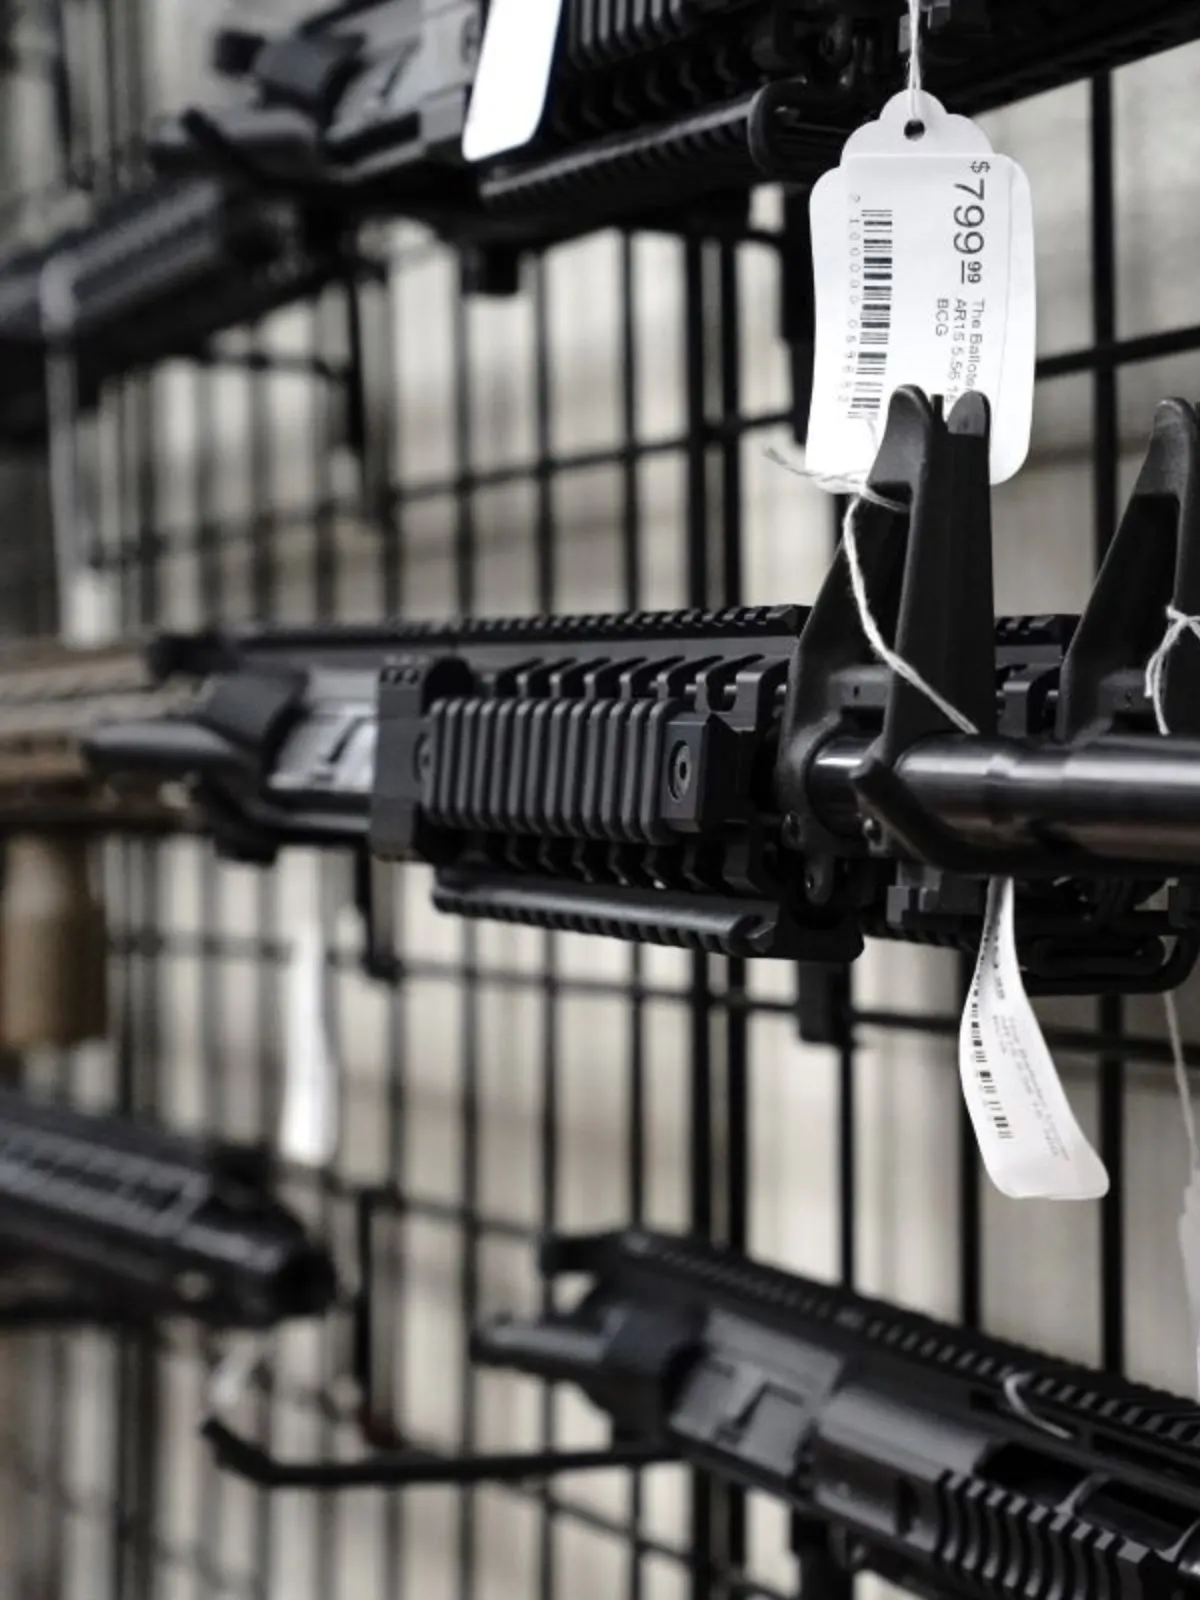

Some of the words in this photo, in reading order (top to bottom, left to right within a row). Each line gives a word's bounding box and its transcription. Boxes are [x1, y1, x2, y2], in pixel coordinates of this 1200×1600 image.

[935, 297, 950, 337] BCG
[953, 298, 968, 342] AR15
[971, 298, 986, 329] The
[966, 333, 983, 393] Ballote
